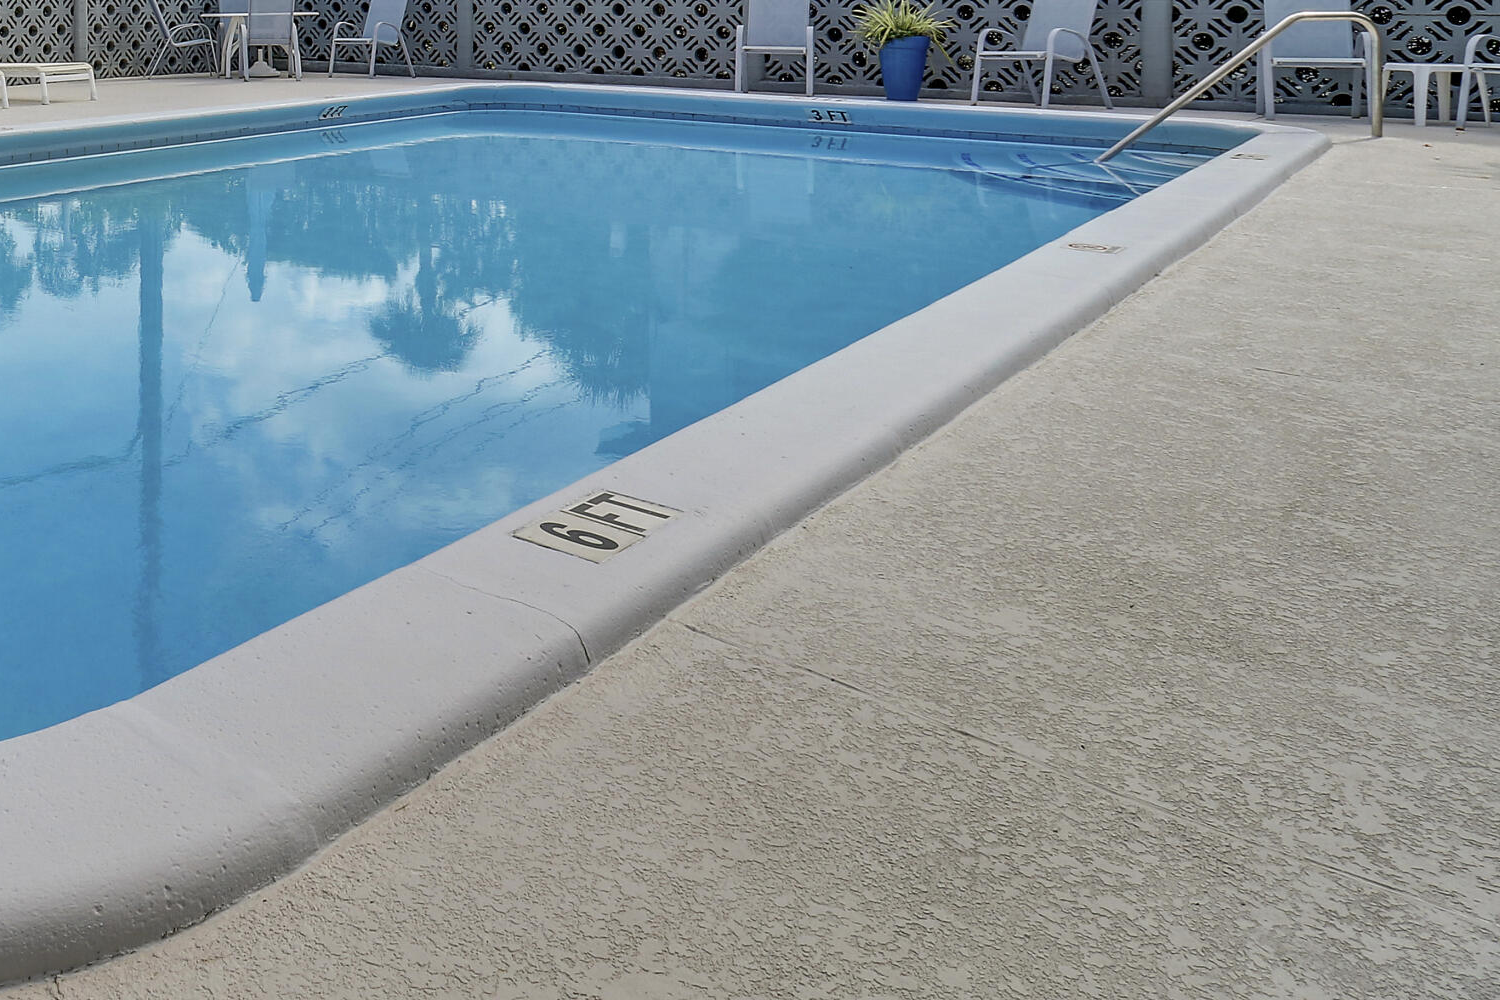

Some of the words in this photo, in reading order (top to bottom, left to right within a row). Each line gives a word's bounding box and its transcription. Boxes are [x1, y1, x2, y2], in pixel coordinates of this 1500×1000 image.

[811, 109, 823, 121] 3
[826, 110, 847, 122] FT
[569, 492, 671, 533] FT
[539, 522, 619, 551] 6
